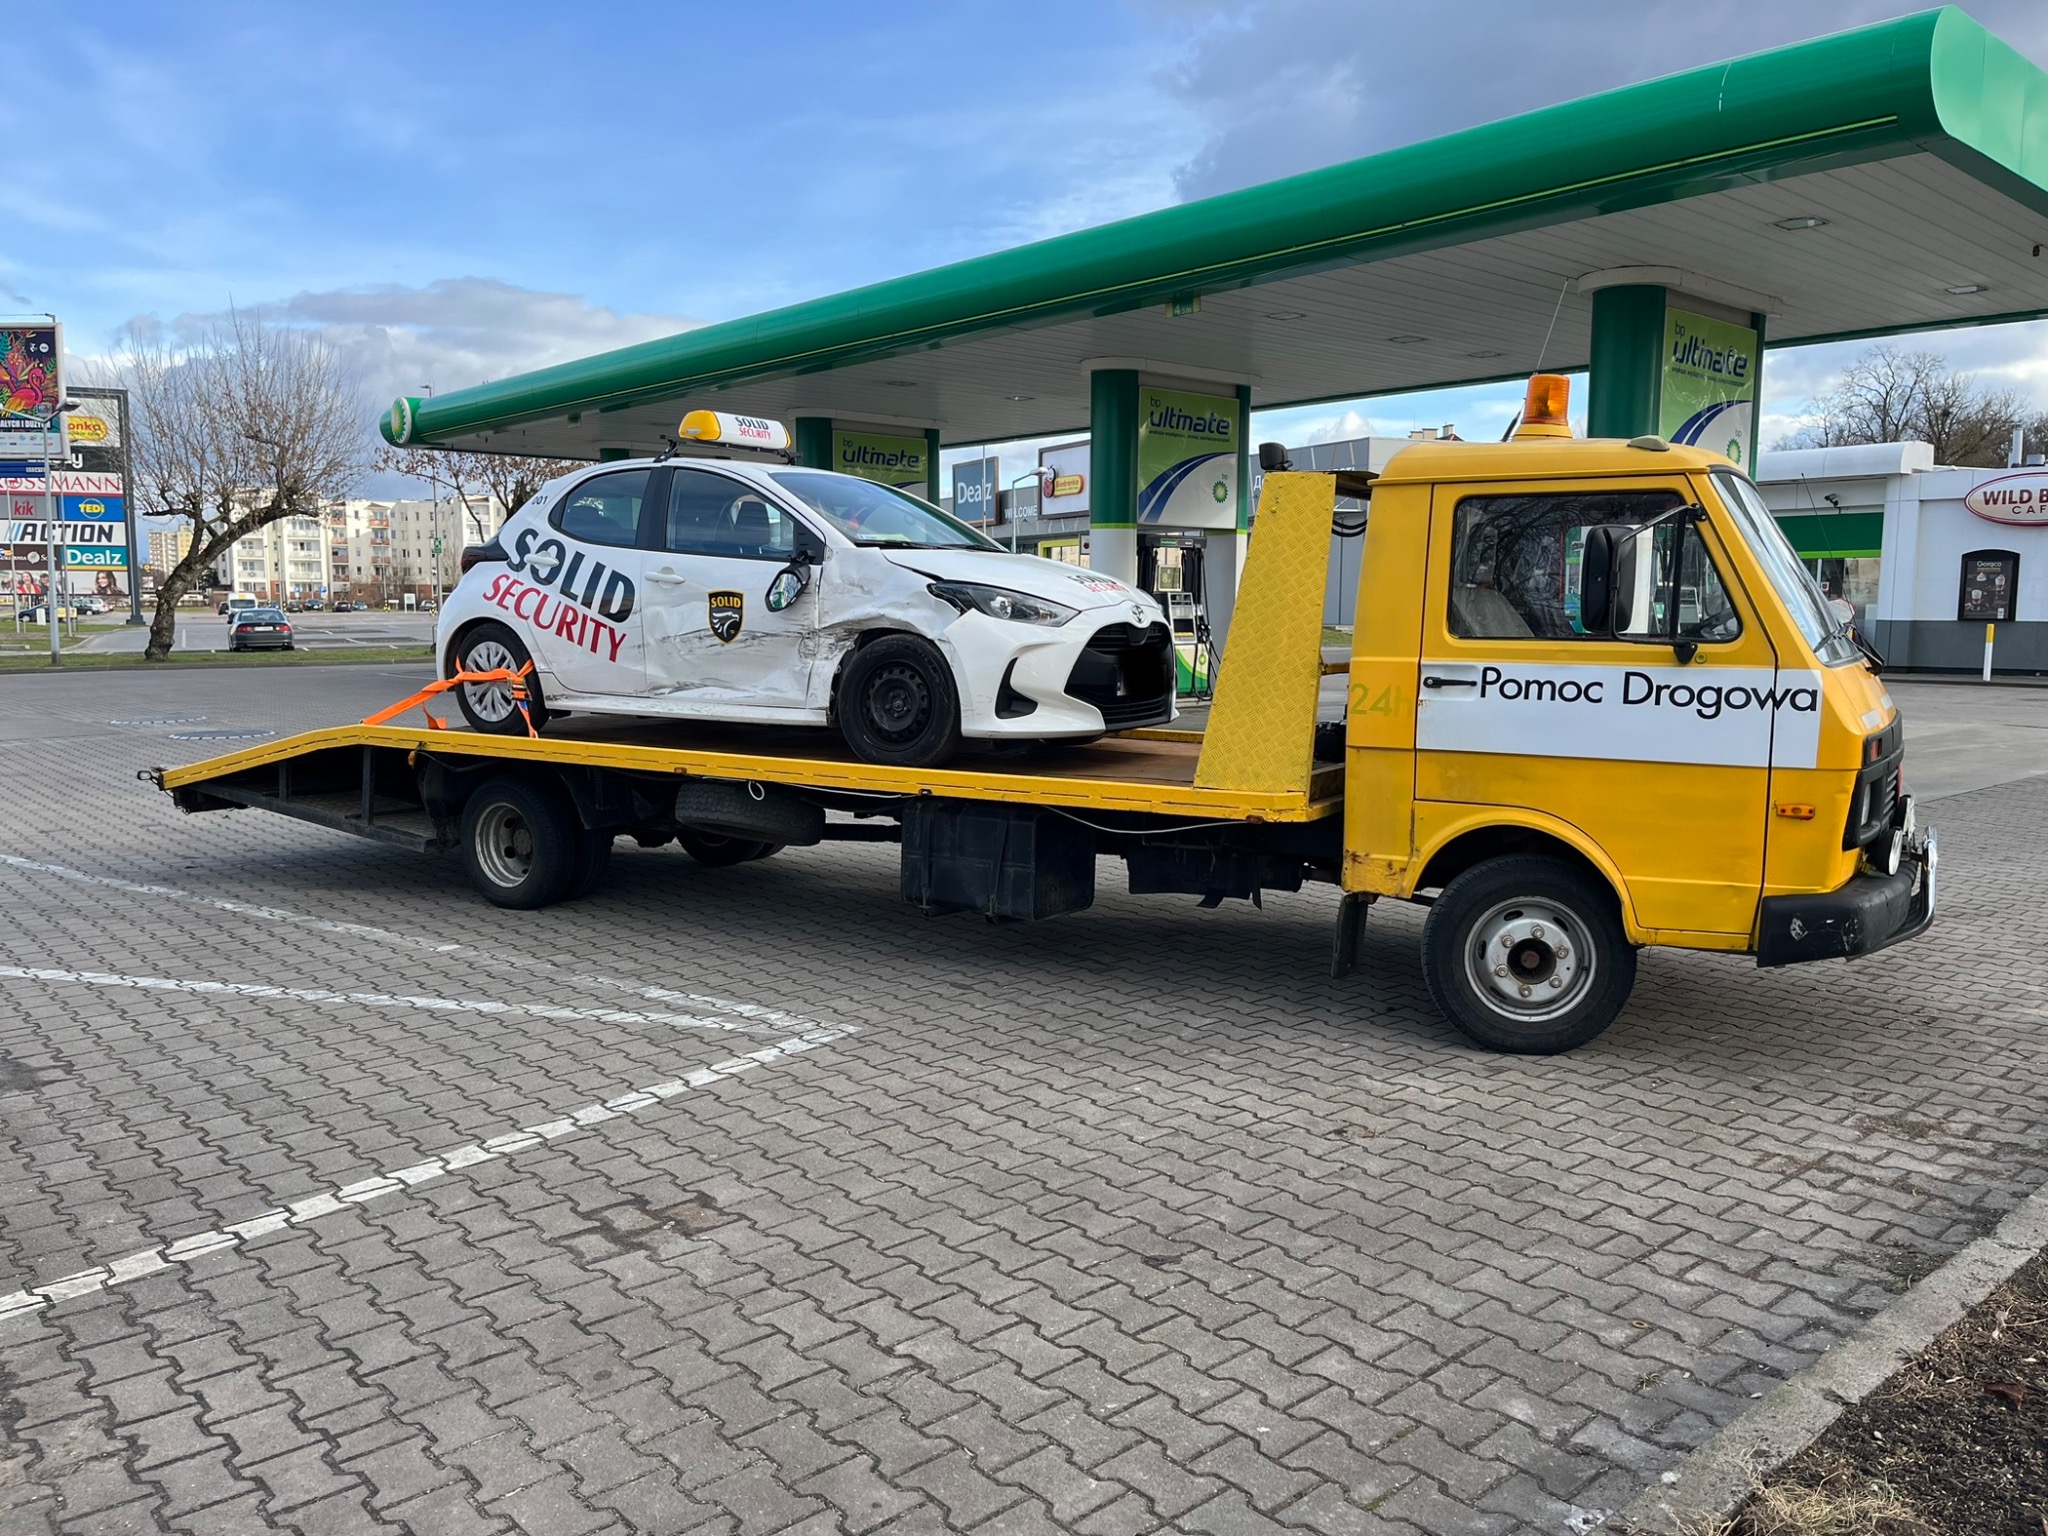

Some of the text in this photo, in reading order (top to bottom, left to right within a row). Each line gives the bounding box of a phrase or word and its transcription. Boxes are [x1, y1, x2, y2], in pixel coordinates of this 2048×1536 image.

[1675, 320, 1686, 338] bp
[1672, 335, 1748, 378] ultimate
[1151, 396, 1161, 408] bp
[68, 422, 102, 431] onka
[735, 416, 769, 430] SOLID
[1149, 406, 1231, 436] ultimate
[739, 427, 771, 440] SECURITY
[843, 438, 853, 447] bp
[842, 446, 920, 468] ultimate
[957, 478, 992, 504] Dealz
[1983, 489, 2032, 506] WILD
[14, 501, 33, 516] kik
[79, 504, 105, 514] TEDi
[1004, 505, 1038, 519] WELCOME
[20, 523, 114, 543] ACTION
[66, 549, 122, 565] Dealz
[506, 528, 636, 623] SOLID
[711, 596, 741, 608] SOLID
[482, 573, 627, 663] SECURITY
[1350, 683, 1413, 719] 24h
[1480, 666, 1818, 720] Pomoc Drogowa
